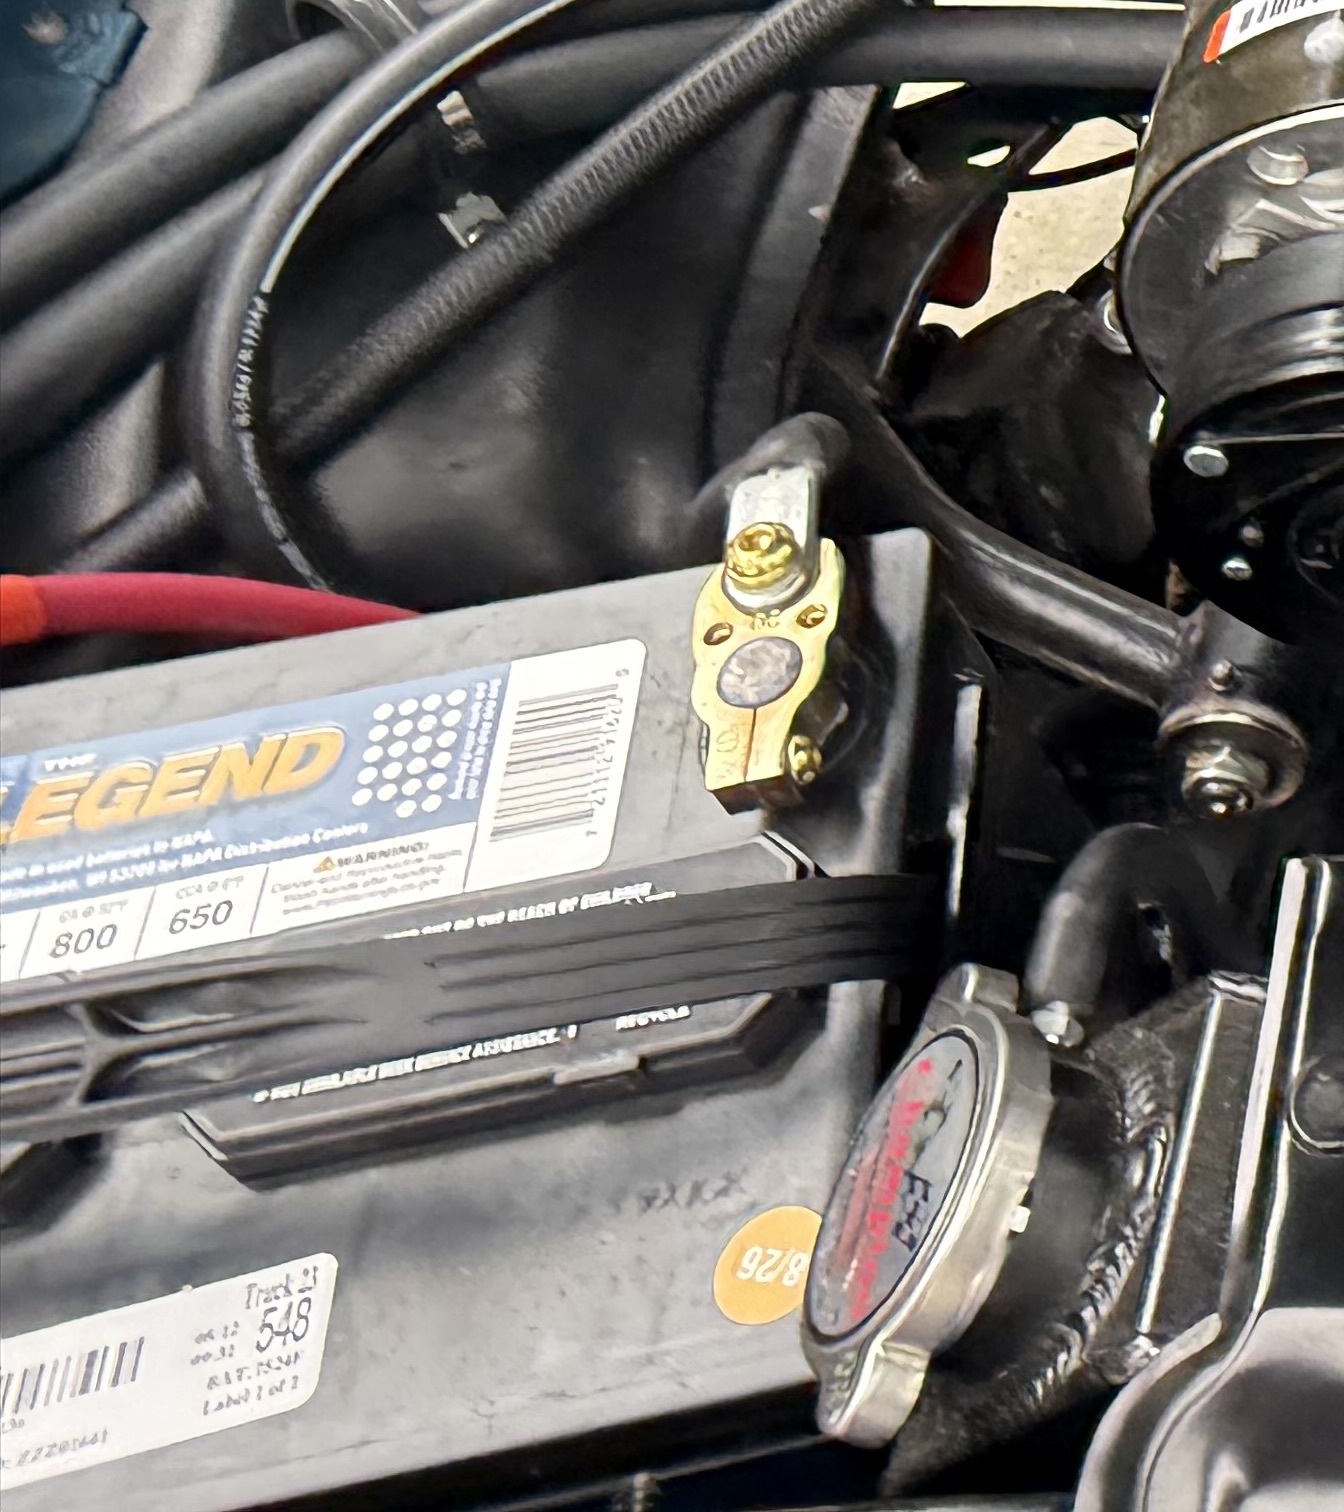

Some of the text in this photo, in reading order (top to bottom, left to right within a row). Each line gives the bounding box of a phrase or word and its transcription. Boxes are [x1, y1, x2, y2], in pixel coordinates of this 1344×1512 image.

[168, 898, 234, 935] 650
[49, 922, 118, 959] 800
[735, 1245, 810, 1288] 8/26
[256, 1296, 313, 1354] 548
